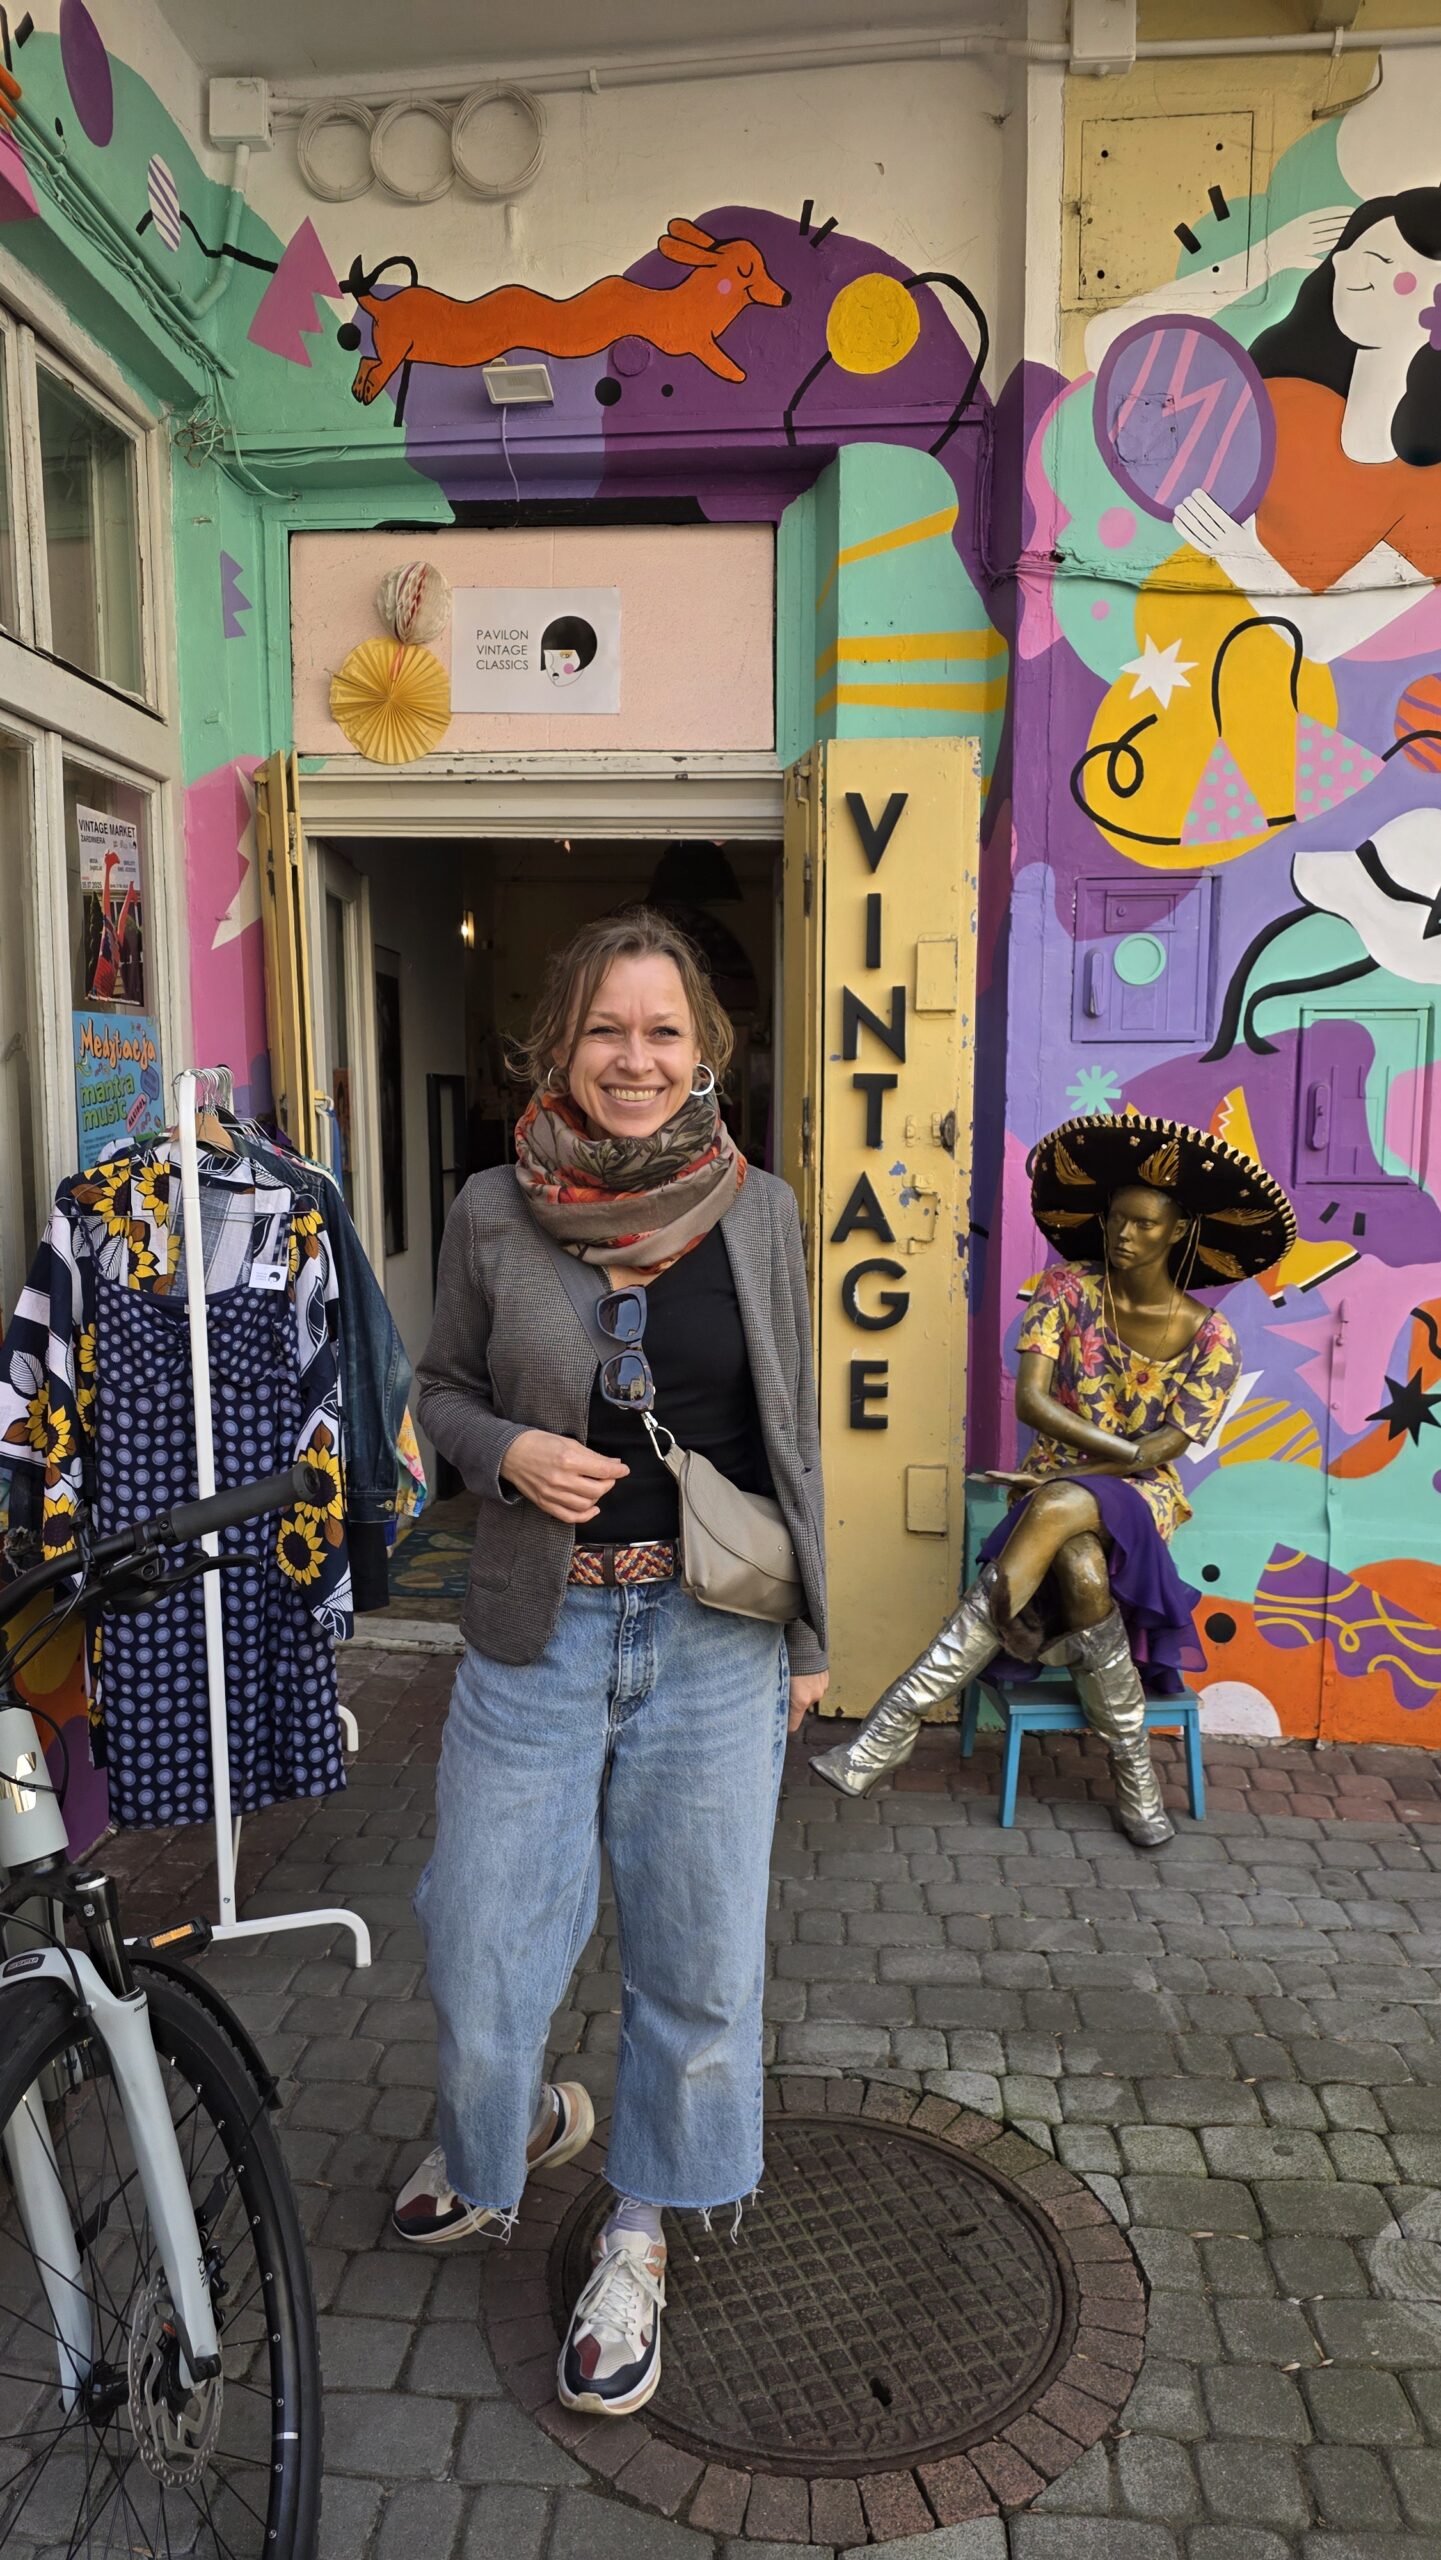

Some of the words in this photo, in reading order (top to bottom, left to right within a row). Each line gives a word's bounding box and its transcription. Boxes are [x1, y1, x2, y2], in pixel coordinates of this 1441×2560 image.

[476, 629, 529, 640] PAVILON
[476, 645, 528, 655] VINTAGE
[476, 660, 529, 670] CLASSICS
[79, 819, 108, 834] VINTAGE
[109, 824, 135, 838] MARKET
[79, 1017, 157, 1071] Medytacja
[80, 1074, 135, 1108] mantra
[83, 1100, 128, 1132] music
[829, 792, 910, 1431] VINTAGE
